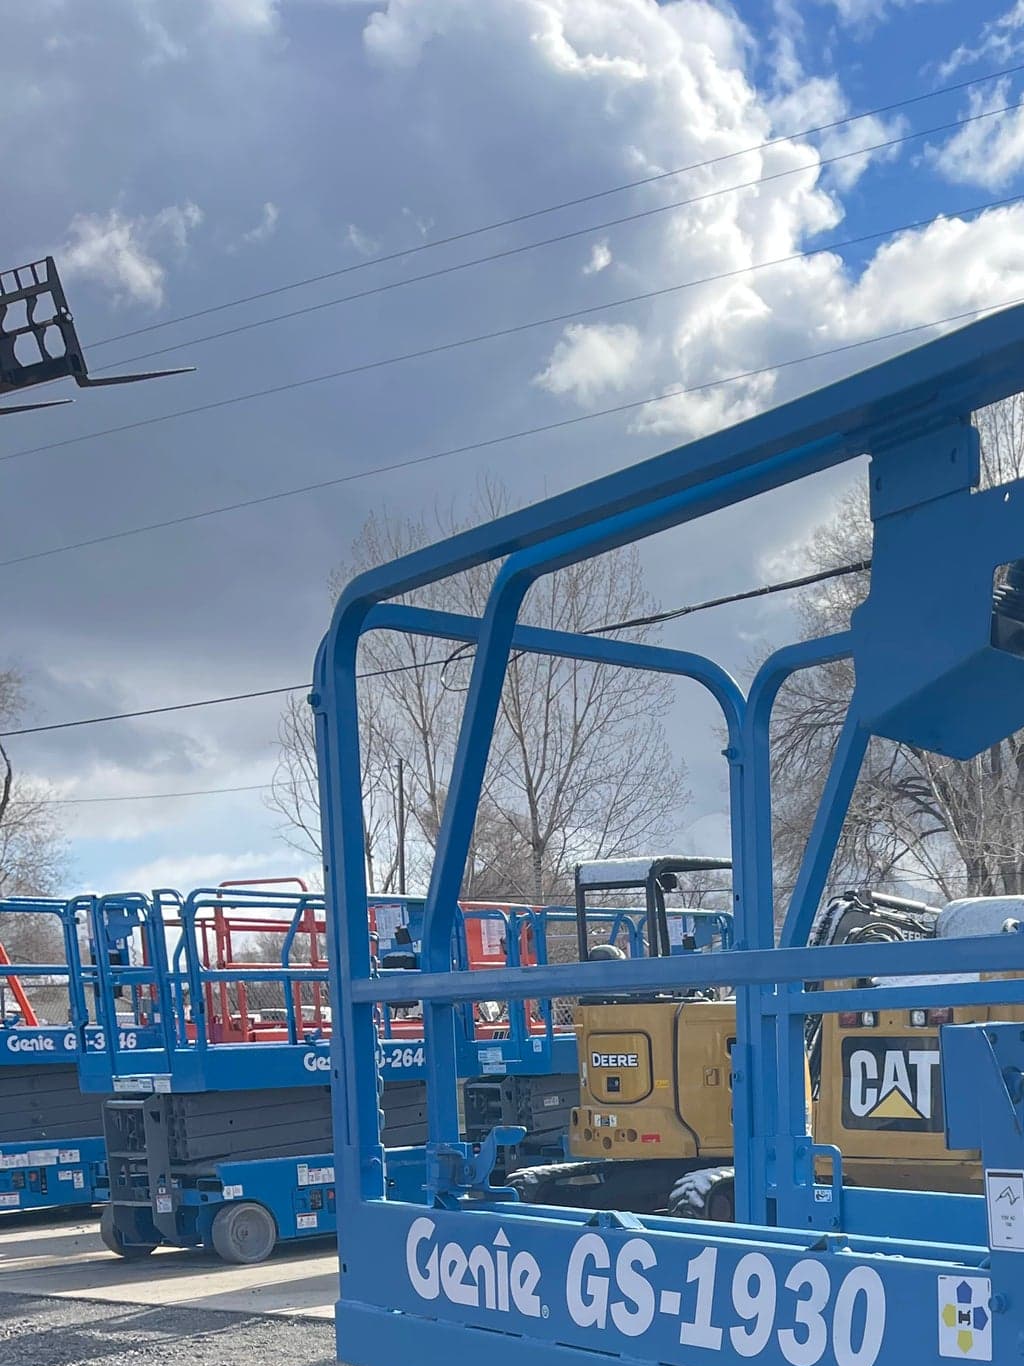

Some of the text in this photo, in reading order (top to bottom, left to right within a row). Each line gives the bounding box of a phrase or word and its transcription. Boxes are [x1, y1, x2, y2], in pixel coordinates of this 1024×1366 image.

[7, 1034, 55, 1052] Genie
[592, 1053, 638, 1067] DEERE
[850, 1050, 940, 1119] CAT
[406, 1217, 542, 1318] Genie
